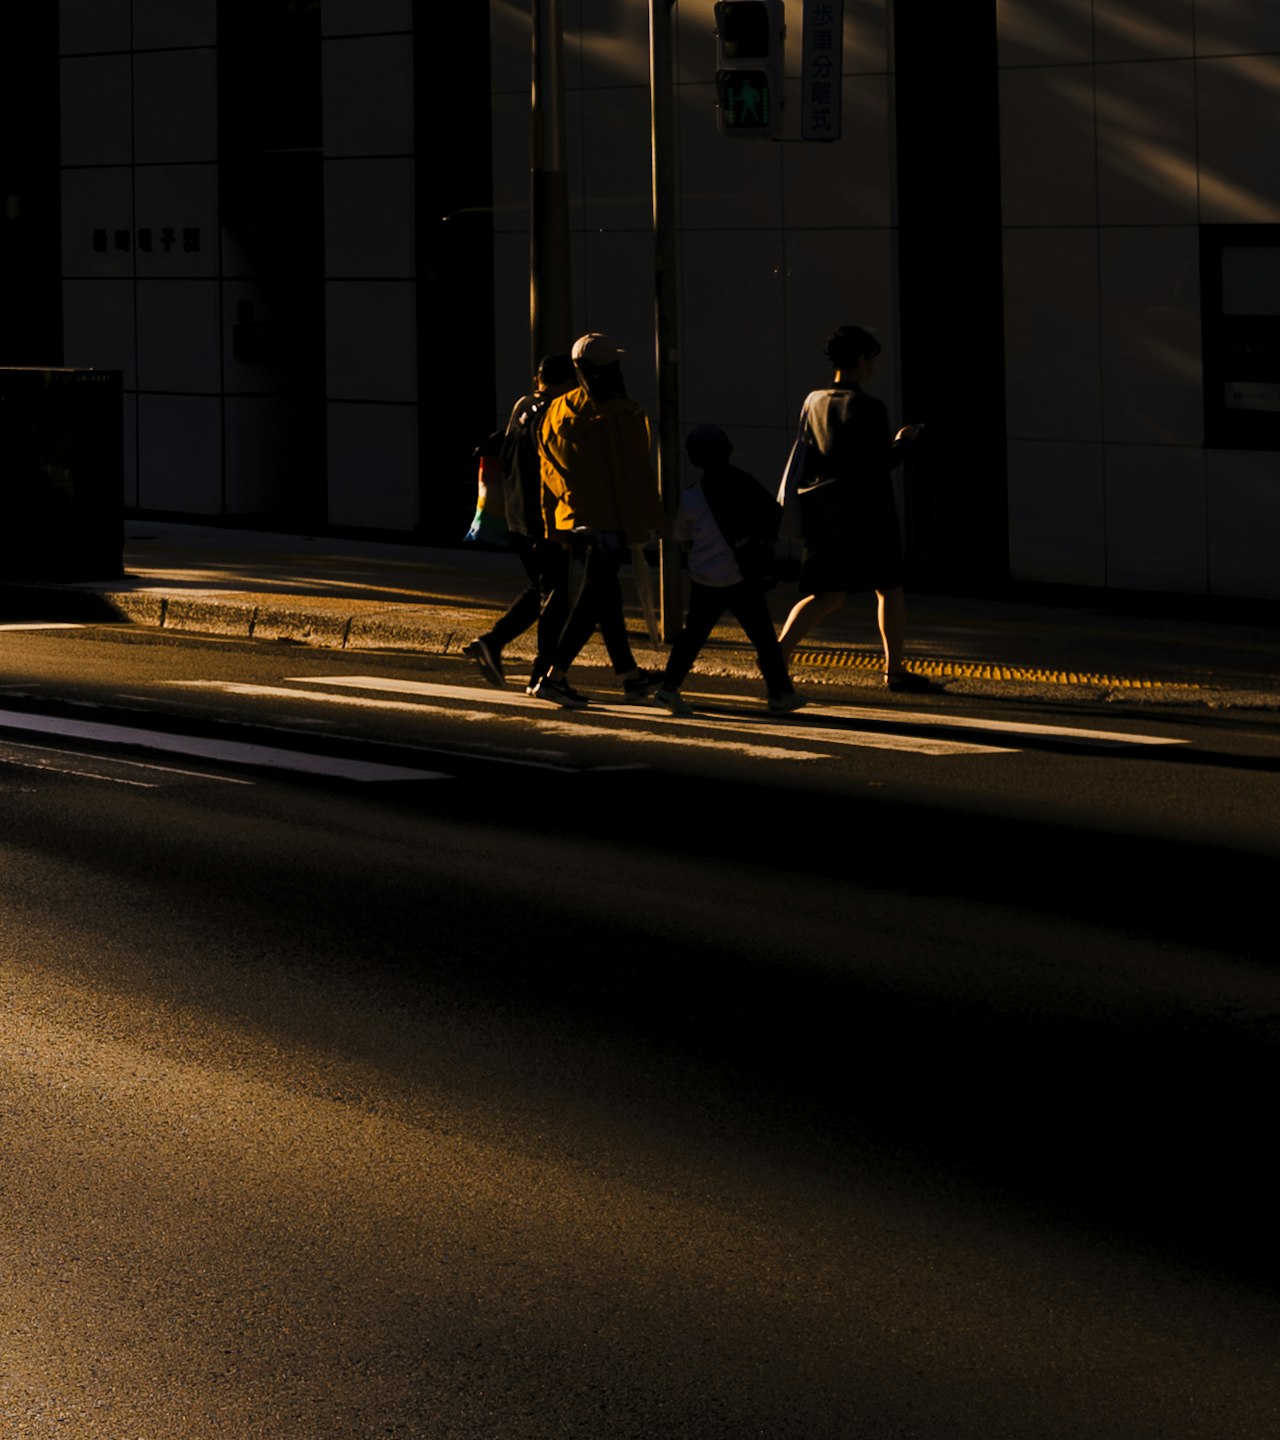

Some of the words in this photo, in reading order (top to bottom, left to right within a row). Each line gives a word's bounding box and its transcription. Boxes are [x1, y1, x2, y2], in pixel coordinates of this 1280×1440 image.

[811, 2, 834, 131] 歩車分離式
